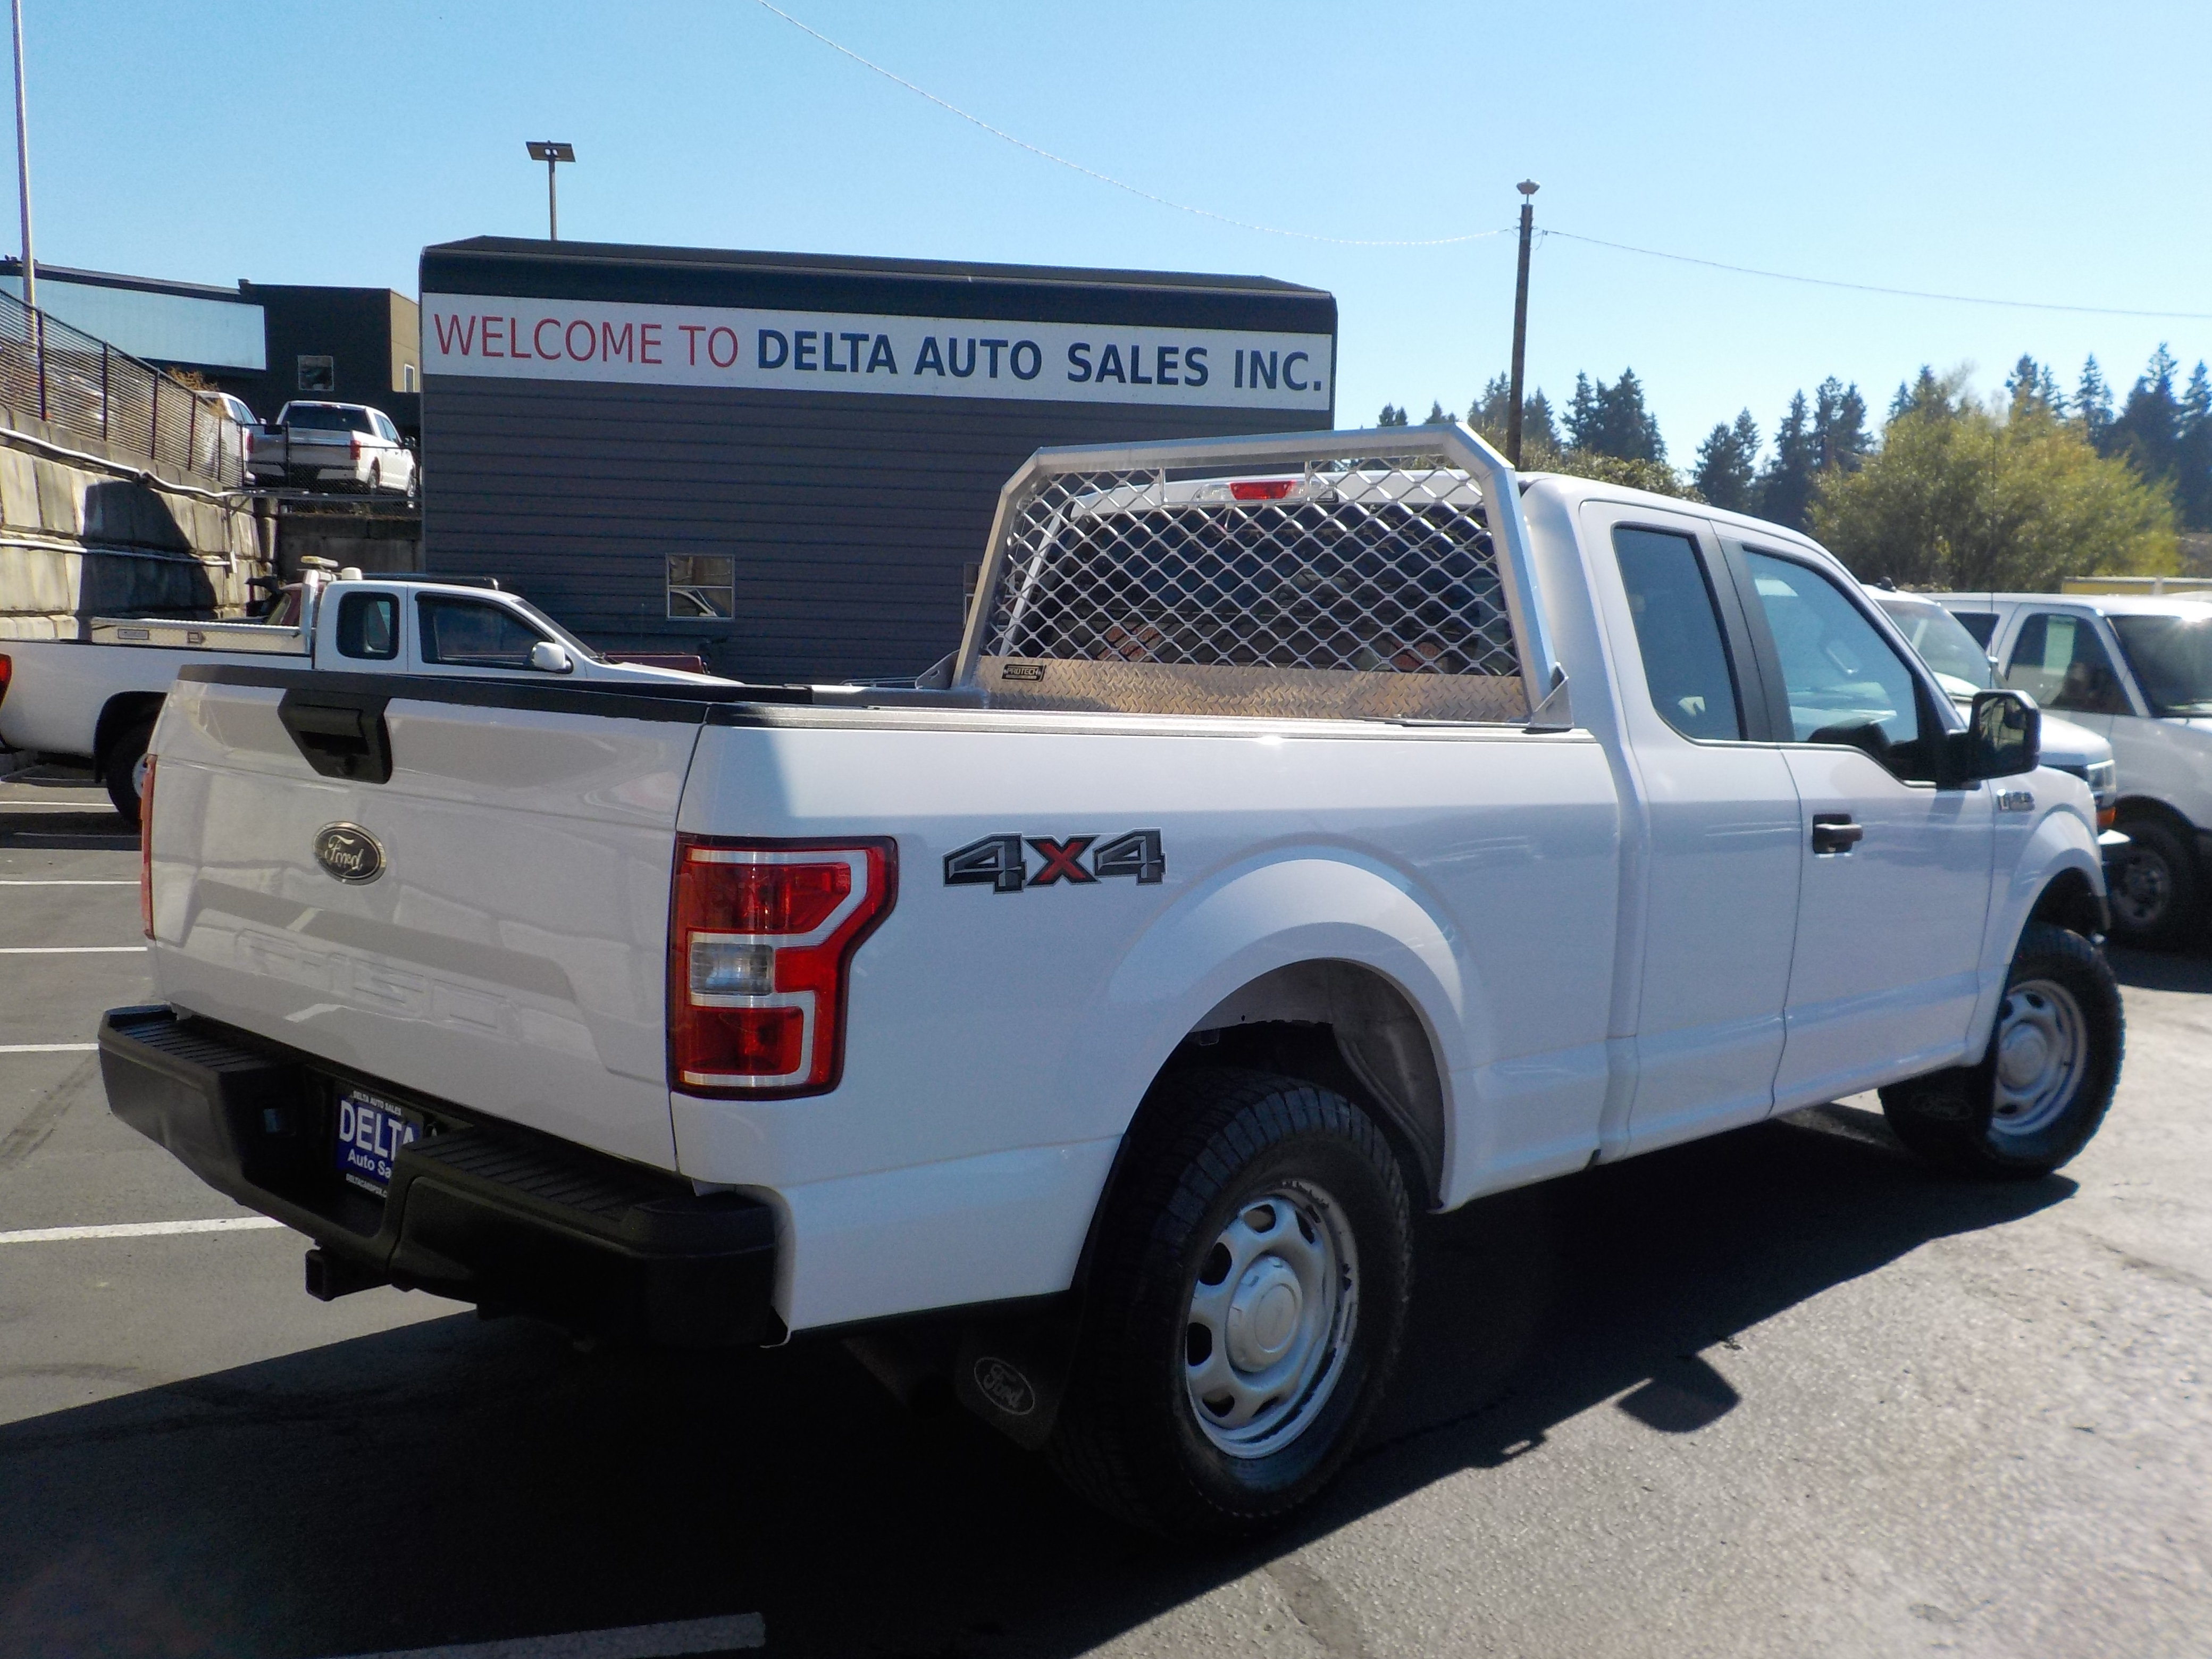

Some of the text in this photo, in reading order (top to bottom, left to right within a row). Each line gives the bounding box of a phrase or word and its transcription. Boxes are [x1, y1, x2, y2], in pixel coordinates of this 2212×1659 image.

[433, 313, 1322, 391] WELCOME TO DELTA AUTO SALES INC.
[324, 834, 365, 873] Ford
[353, 1090, 402, 1116] DELTA AUTO SALES
[347, 1149, 375, 1171] Auto
